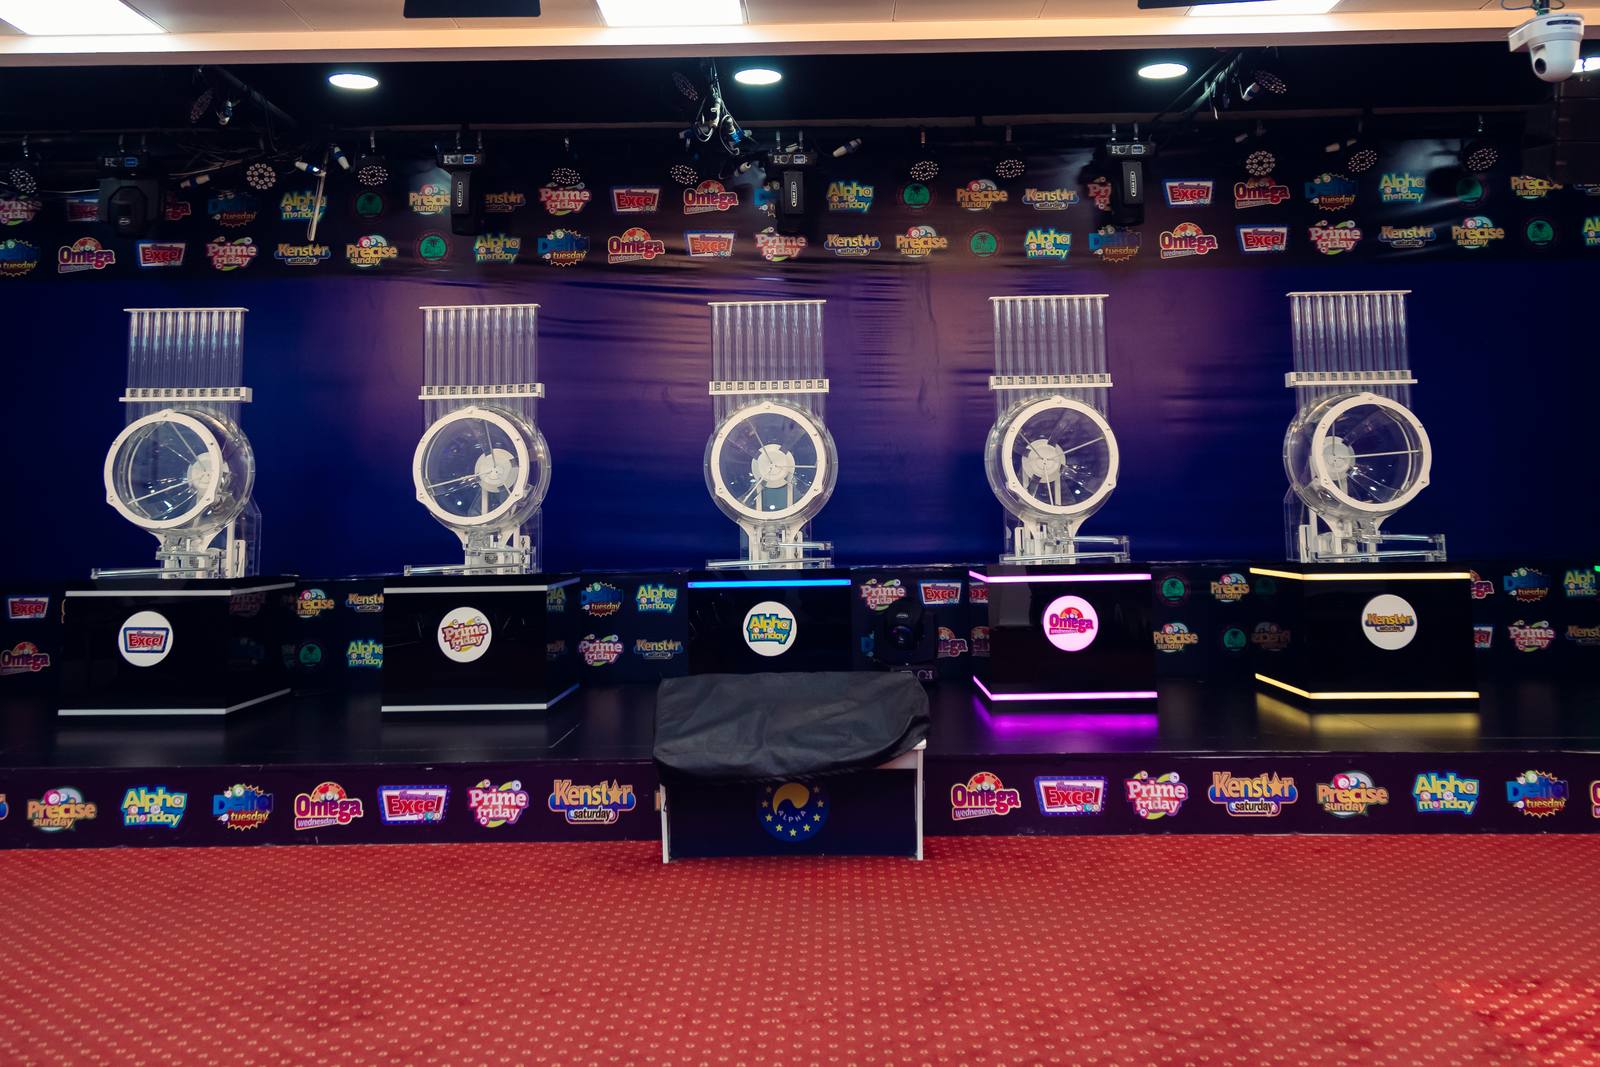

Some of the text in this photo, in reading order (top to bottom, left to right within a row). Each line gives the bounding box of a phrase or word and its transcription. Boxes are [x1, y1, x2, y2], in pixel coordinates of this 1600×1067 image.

[827, 182, 873, 202] Alpha
[1381, 174, 1425, 196] Alpha
[409, 190, 450, 208] Precis
[540, 186, 590, 202] Prime
[684, 189, 738, 210] Omega
[957, 186, 1008, 204] Precise
[1171, 186, 1211, 201] Excel
[1235, 183, 1290, 205] Omega
[545, 199, 584, 214] friday
[617, 195, 656, 208] Excel
[755, 234, 807, 249] Prime
[1026, 229, 1071, 250] Alpha
[1245, 234, 1284, 247] Excel
[1309, 227, 1361, 242] Prime
[1452, 226, 1505, 243] Precise
[208, 242, 257, 257] Prime
[476, 234, 520, 255] Alpha
[609, 237, 665, 259] Omega
[693, 239, 731, 253] Excel
[896, 234, 948, 252] Precise
[1161, 232, 1217, 255] Omega
[1316, 239, 1355, 252] friday
[1456, 238, 1489, 248] sunday
[59, 247, 115, 269] Omega
[142, 248, 183, 263] Excel
[346, 243, 397, 260] Precise
[552, 250, 587, 260] tuesday
[900, 248, 932, 257] sunday
[1027, 246, 1068, 258] monday
[350, 256, 381, 267] sunday
[1210, 580, 1249, 595] Precis
[1564, 570, 1596, 590] Alph
[636, 584, 677, 603] Alpha
[861, 584, 906, 599] Prime
[924, 587, 959, 601] Excel
[11, 602, 46, 615] Excel
[296, 596, 335, 609] recise
[638, 600, 675, 613] monday
[297, 607, 321, 617] unday
[749, 615, 792, 635] Alpha
[1049, 614, 1094, 634] Omega
[442, 623, 488, 642] Prime
[751, 630, 788, 642] monday
[1152, 630, 1199, 646] Precise
[1508, 626, 1556, 641] Prime
[128, 633, 163, 648] Excel
[451, 636, 482, 650] friday
[579, 640, 624, 656] Prime
[1, 650, 50, 671] Omega
[1126, 779, 1186, 799] Prime
[1316, 782, 1389, 804] Precise
[1415, 773, 1479, 798] Alpha
[123, 788, 185, 812] Alpha
[469, 788, 527, 808] Prime
[952, 784, 1021, 815] Omega
[1044, 785, 1100, 806] Excel
[1525, 797, 1566, 808] tuesday
[26, 798, 97, 819] Precise
[295, 794, 363, 826] Omega
[390, 796, 442, 814] Excel
[1135, 796, 1180, 813] friday
[1235, 800, 1273, 815] saturday
[1323, 801, 1366, 813] sunday
[1418, 797, 1475, 812] monday
[126, 811, 180, 826] monday
[230, 811, 270, 822] tuesday
[476, 805, 520, 822] friday
[573, 807, 612, 821] saturday
[955, 807, 995, 818] wednesday
[33, 816, 75, 829] sunday
[297, 817, 338, 827] wednesday
